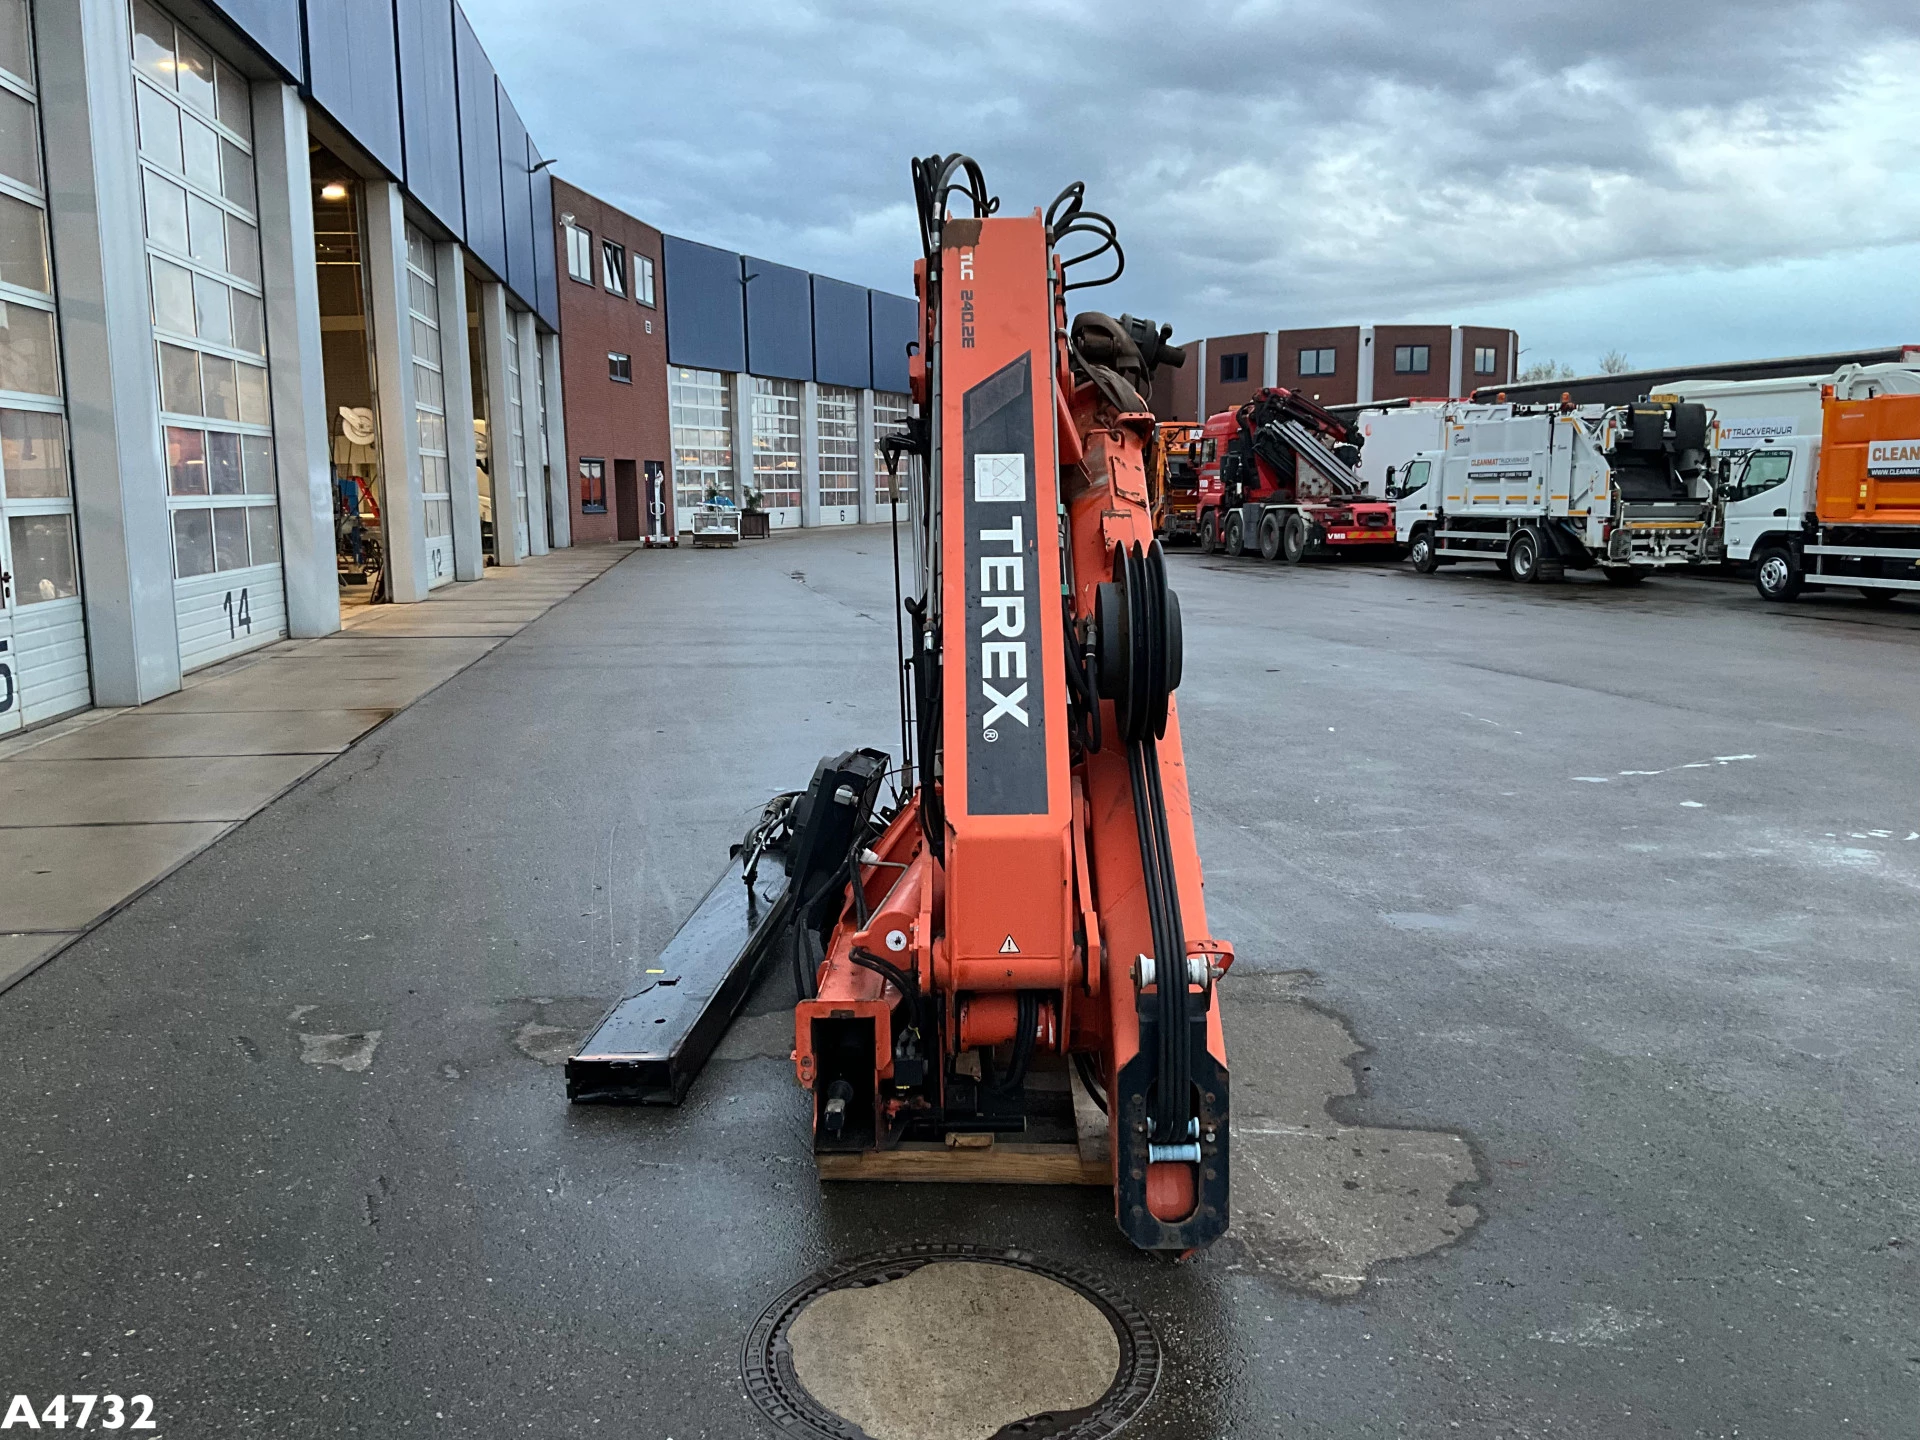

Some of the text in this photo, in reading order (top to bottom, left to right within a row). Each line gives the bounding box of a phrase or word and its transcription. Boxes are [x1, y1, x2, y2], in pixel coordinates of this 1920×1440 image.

[961, 252, 975, 348] TLC 240.2E
[1733, 426, 1792, 436] TRUCKVERHUUR
[1872, 446, 1920, 461] CLEAN
[1471, 458, 1499, 467] CLEANMAT
[780, 512, 785, 525] 7
[840, 510, 845, 522] 6
[432, 548, 443, 578] 12
[223, 588, 251, 640] 14
[980, 515, 1029, 728] TEREX
